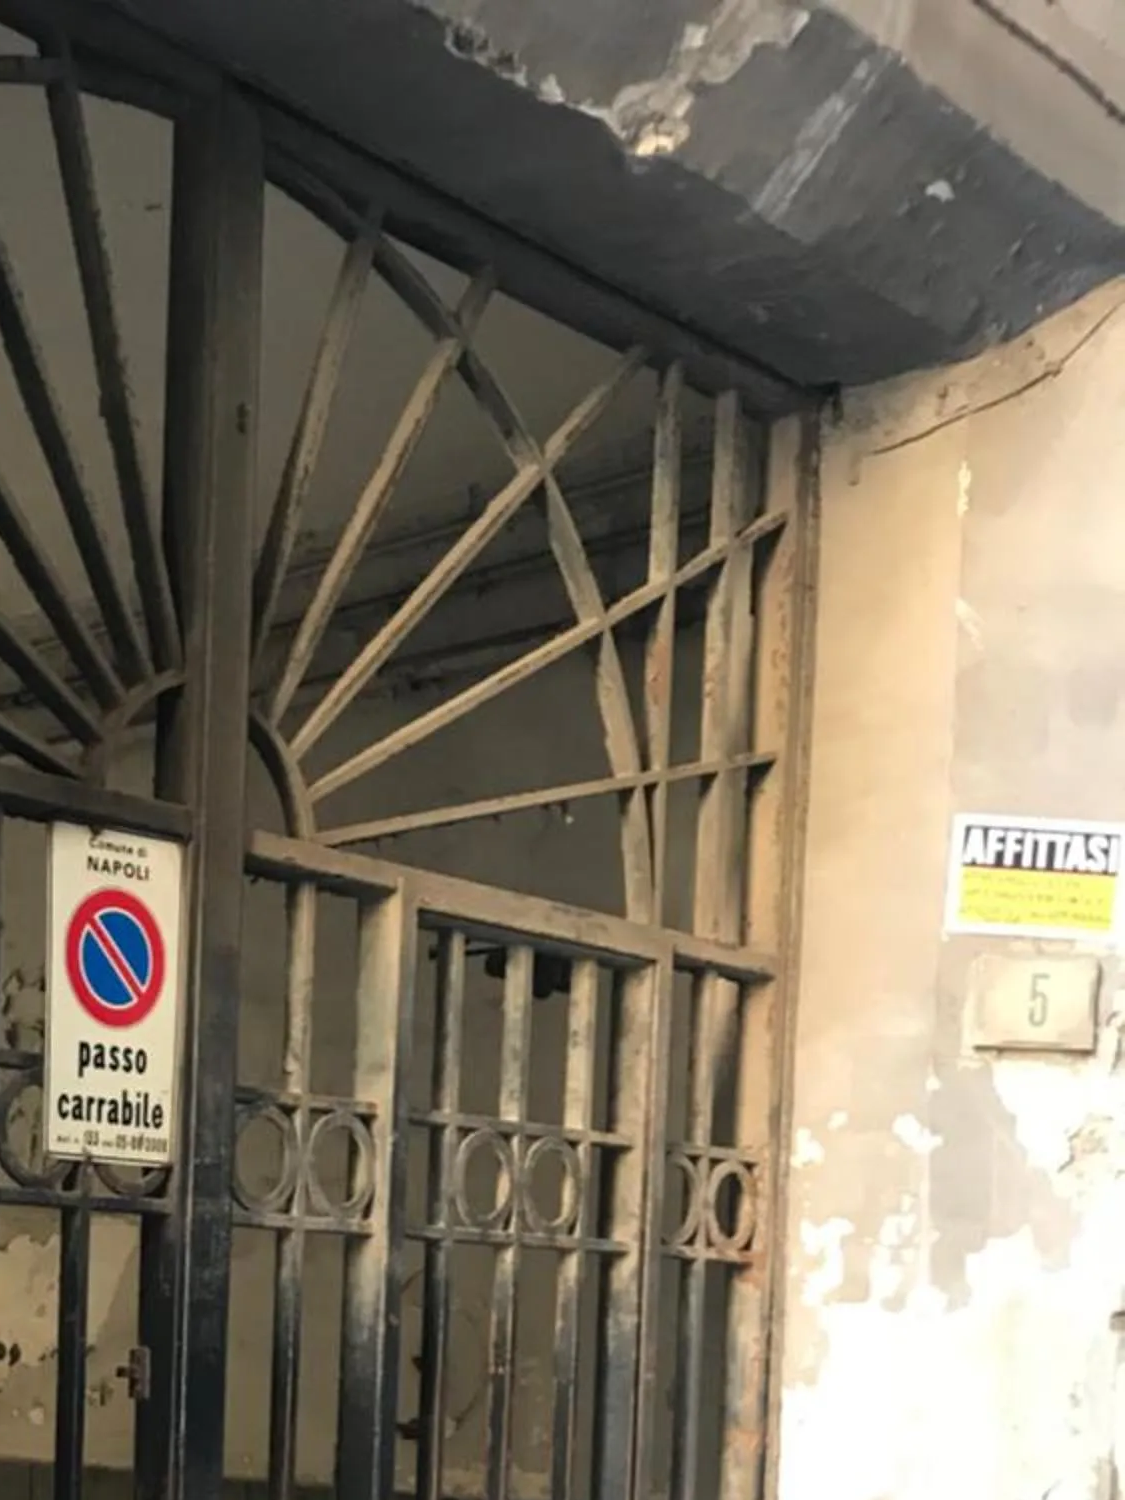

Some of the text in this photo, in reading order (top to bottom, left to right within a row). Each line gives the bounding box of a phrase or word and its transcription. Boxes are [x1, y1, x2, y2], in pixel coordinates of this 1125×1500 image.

[86, 856, 150, 881] NAPOLI
[961, 825, 1120, 875] AFFITTASI
[1028, 972, 1051, 1028] 5
[78, 1040, 148, 1077] passo
[57, 1089, 164, 1129] carrabile
